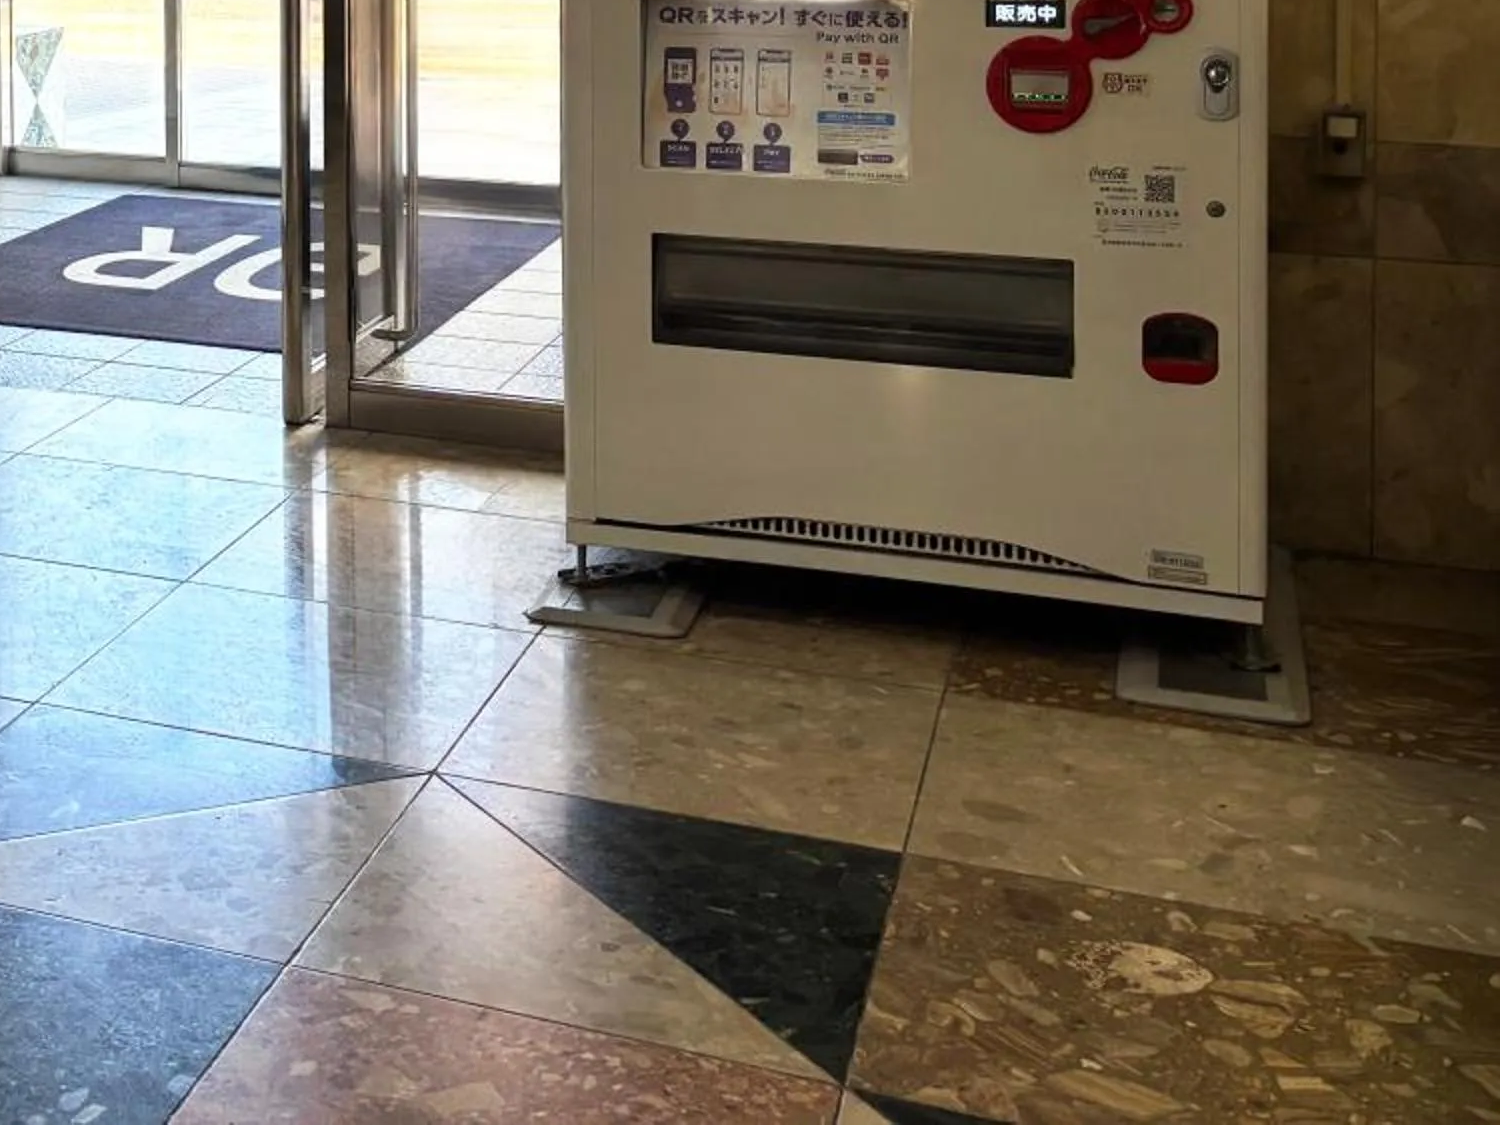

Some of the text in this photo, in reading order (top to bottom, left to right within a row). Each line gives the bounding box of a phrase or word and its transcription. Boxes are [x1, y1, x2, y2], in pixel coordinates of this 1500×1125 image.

[659, 6, 908, 29] QRをスキャン! すぐに使える!
[995, 4, 1057, 24] 販売中
[816, 31, 900, 45] Pay with QR
